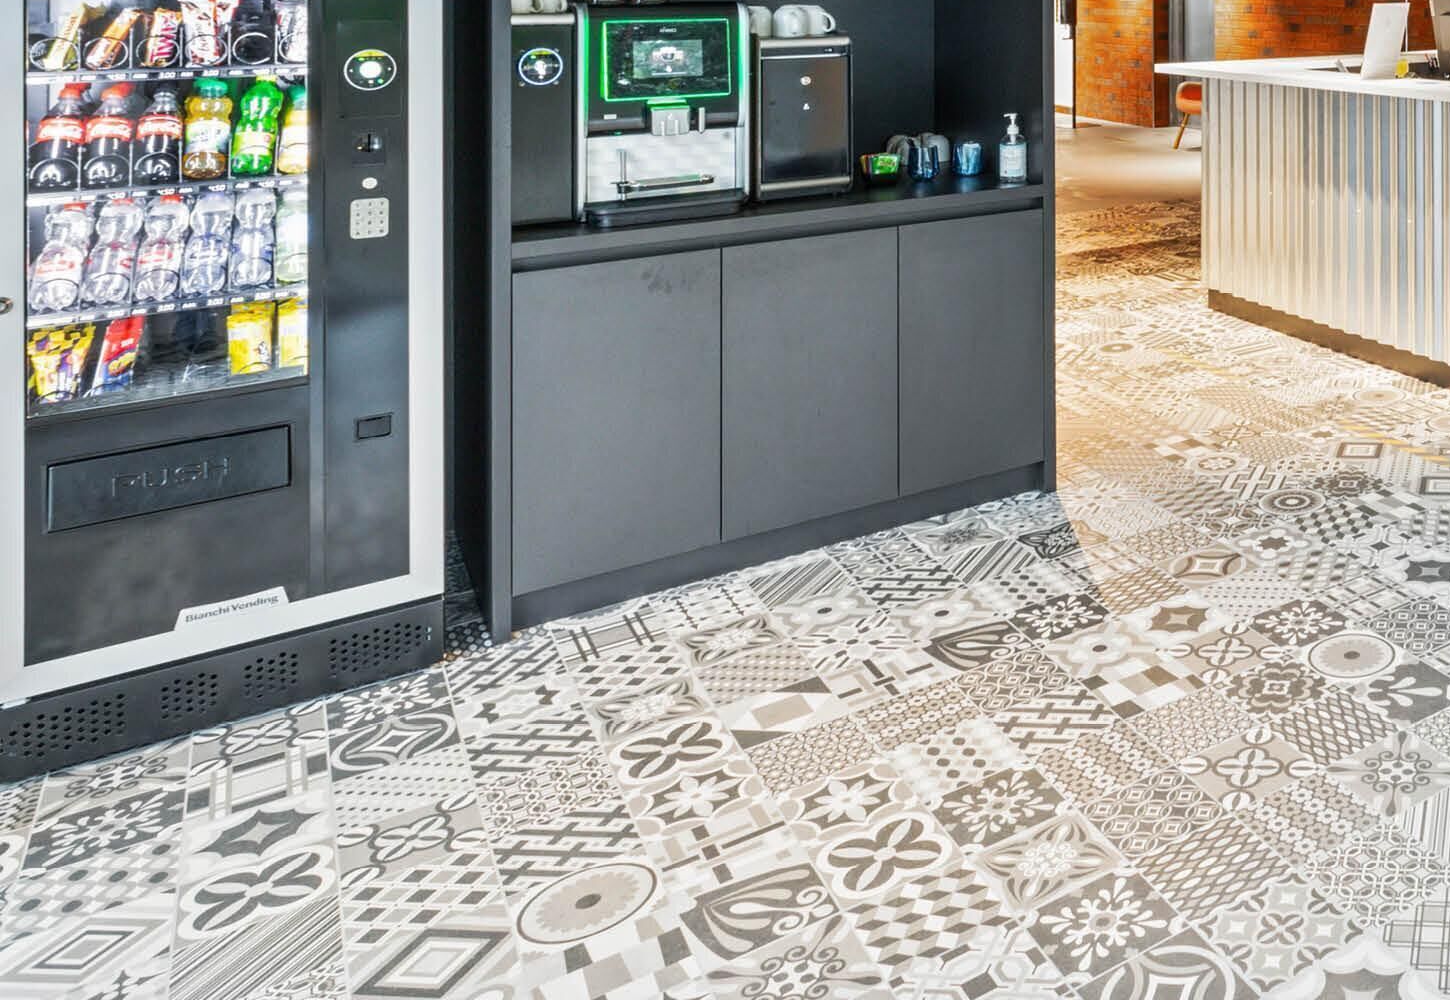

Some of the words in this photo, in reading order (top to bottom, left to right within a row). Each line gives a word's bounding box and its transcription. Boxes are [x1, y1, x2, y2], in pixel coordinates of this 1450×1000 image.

[111, 454, 232, 498] PUSH
[185, 604, 230, 623] Bianchi
[231, 594, 279, 613] Vending
